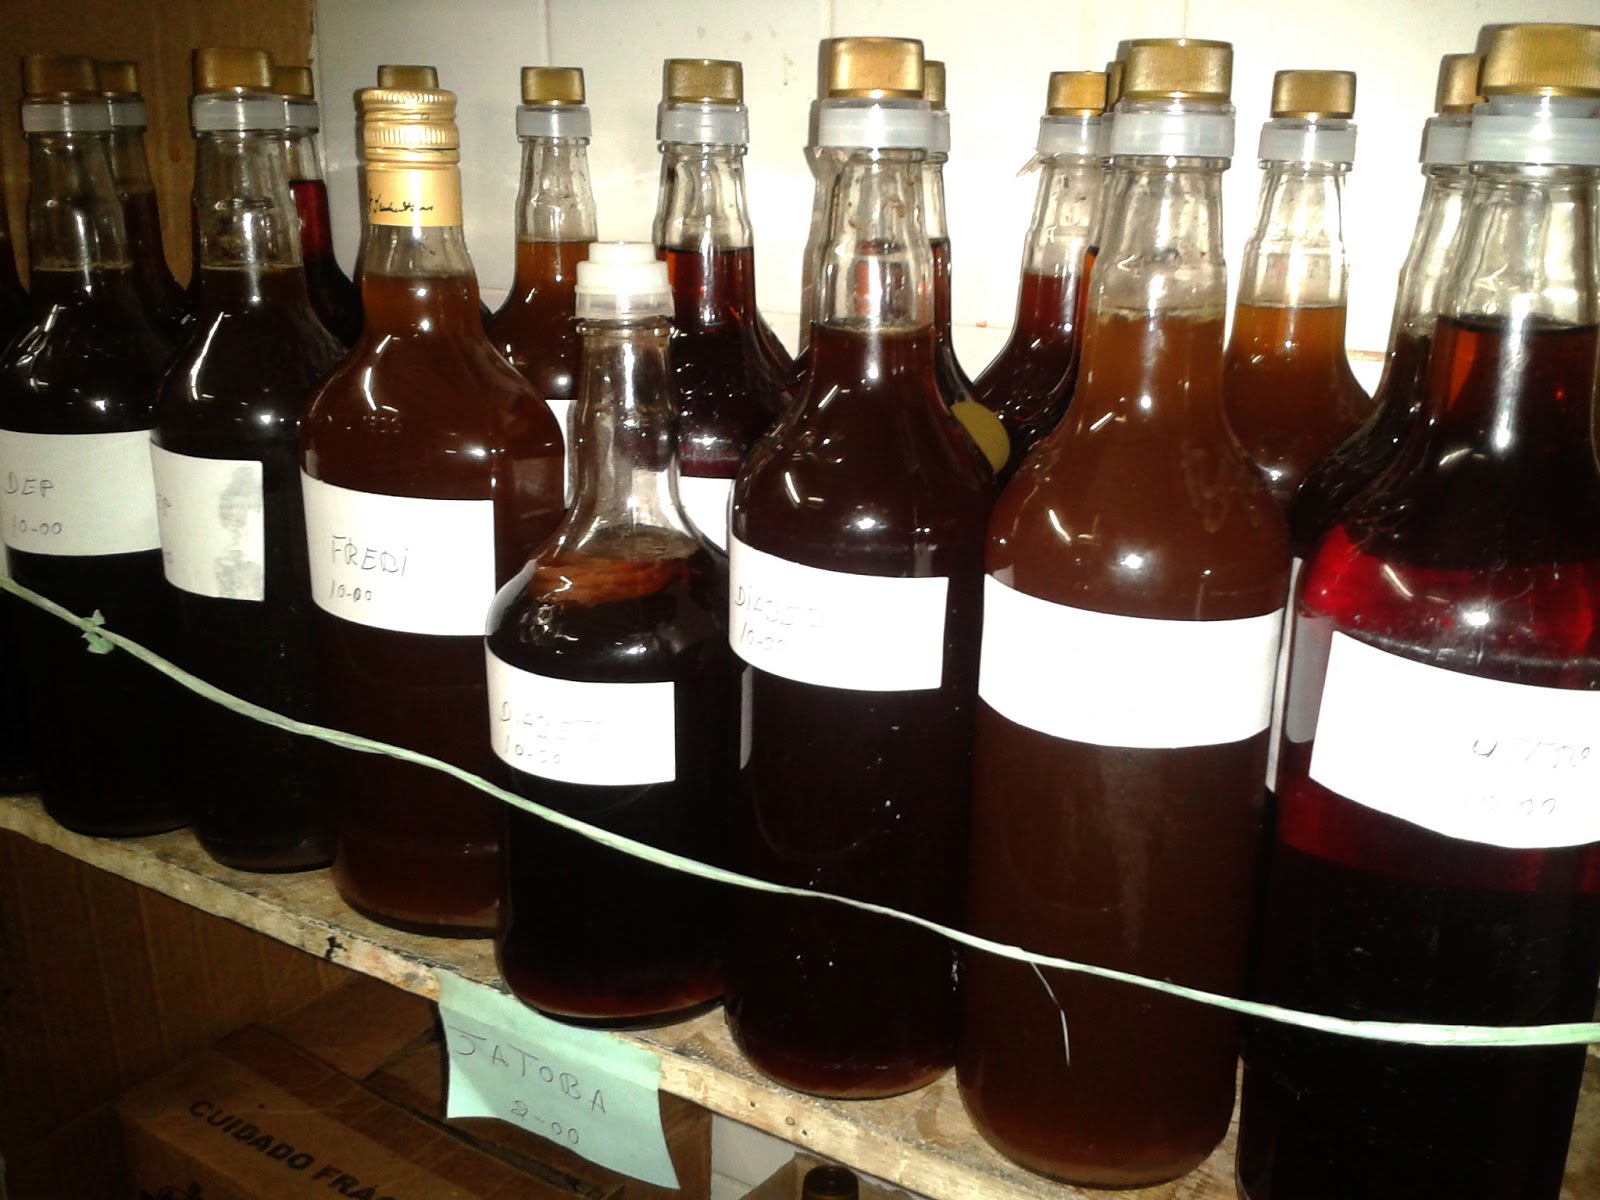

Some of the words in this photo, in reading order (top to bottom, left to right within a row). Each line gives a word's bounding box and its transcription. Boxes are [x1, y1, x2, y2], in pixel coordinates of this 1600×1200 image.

[329, 579, 373, 603] 10-00
[447, 1025, 607, 1114] JATOBA
[188, 1100, 315, 1170] CUIDADO
[312, 1163, 399, 1200] FRÁ
